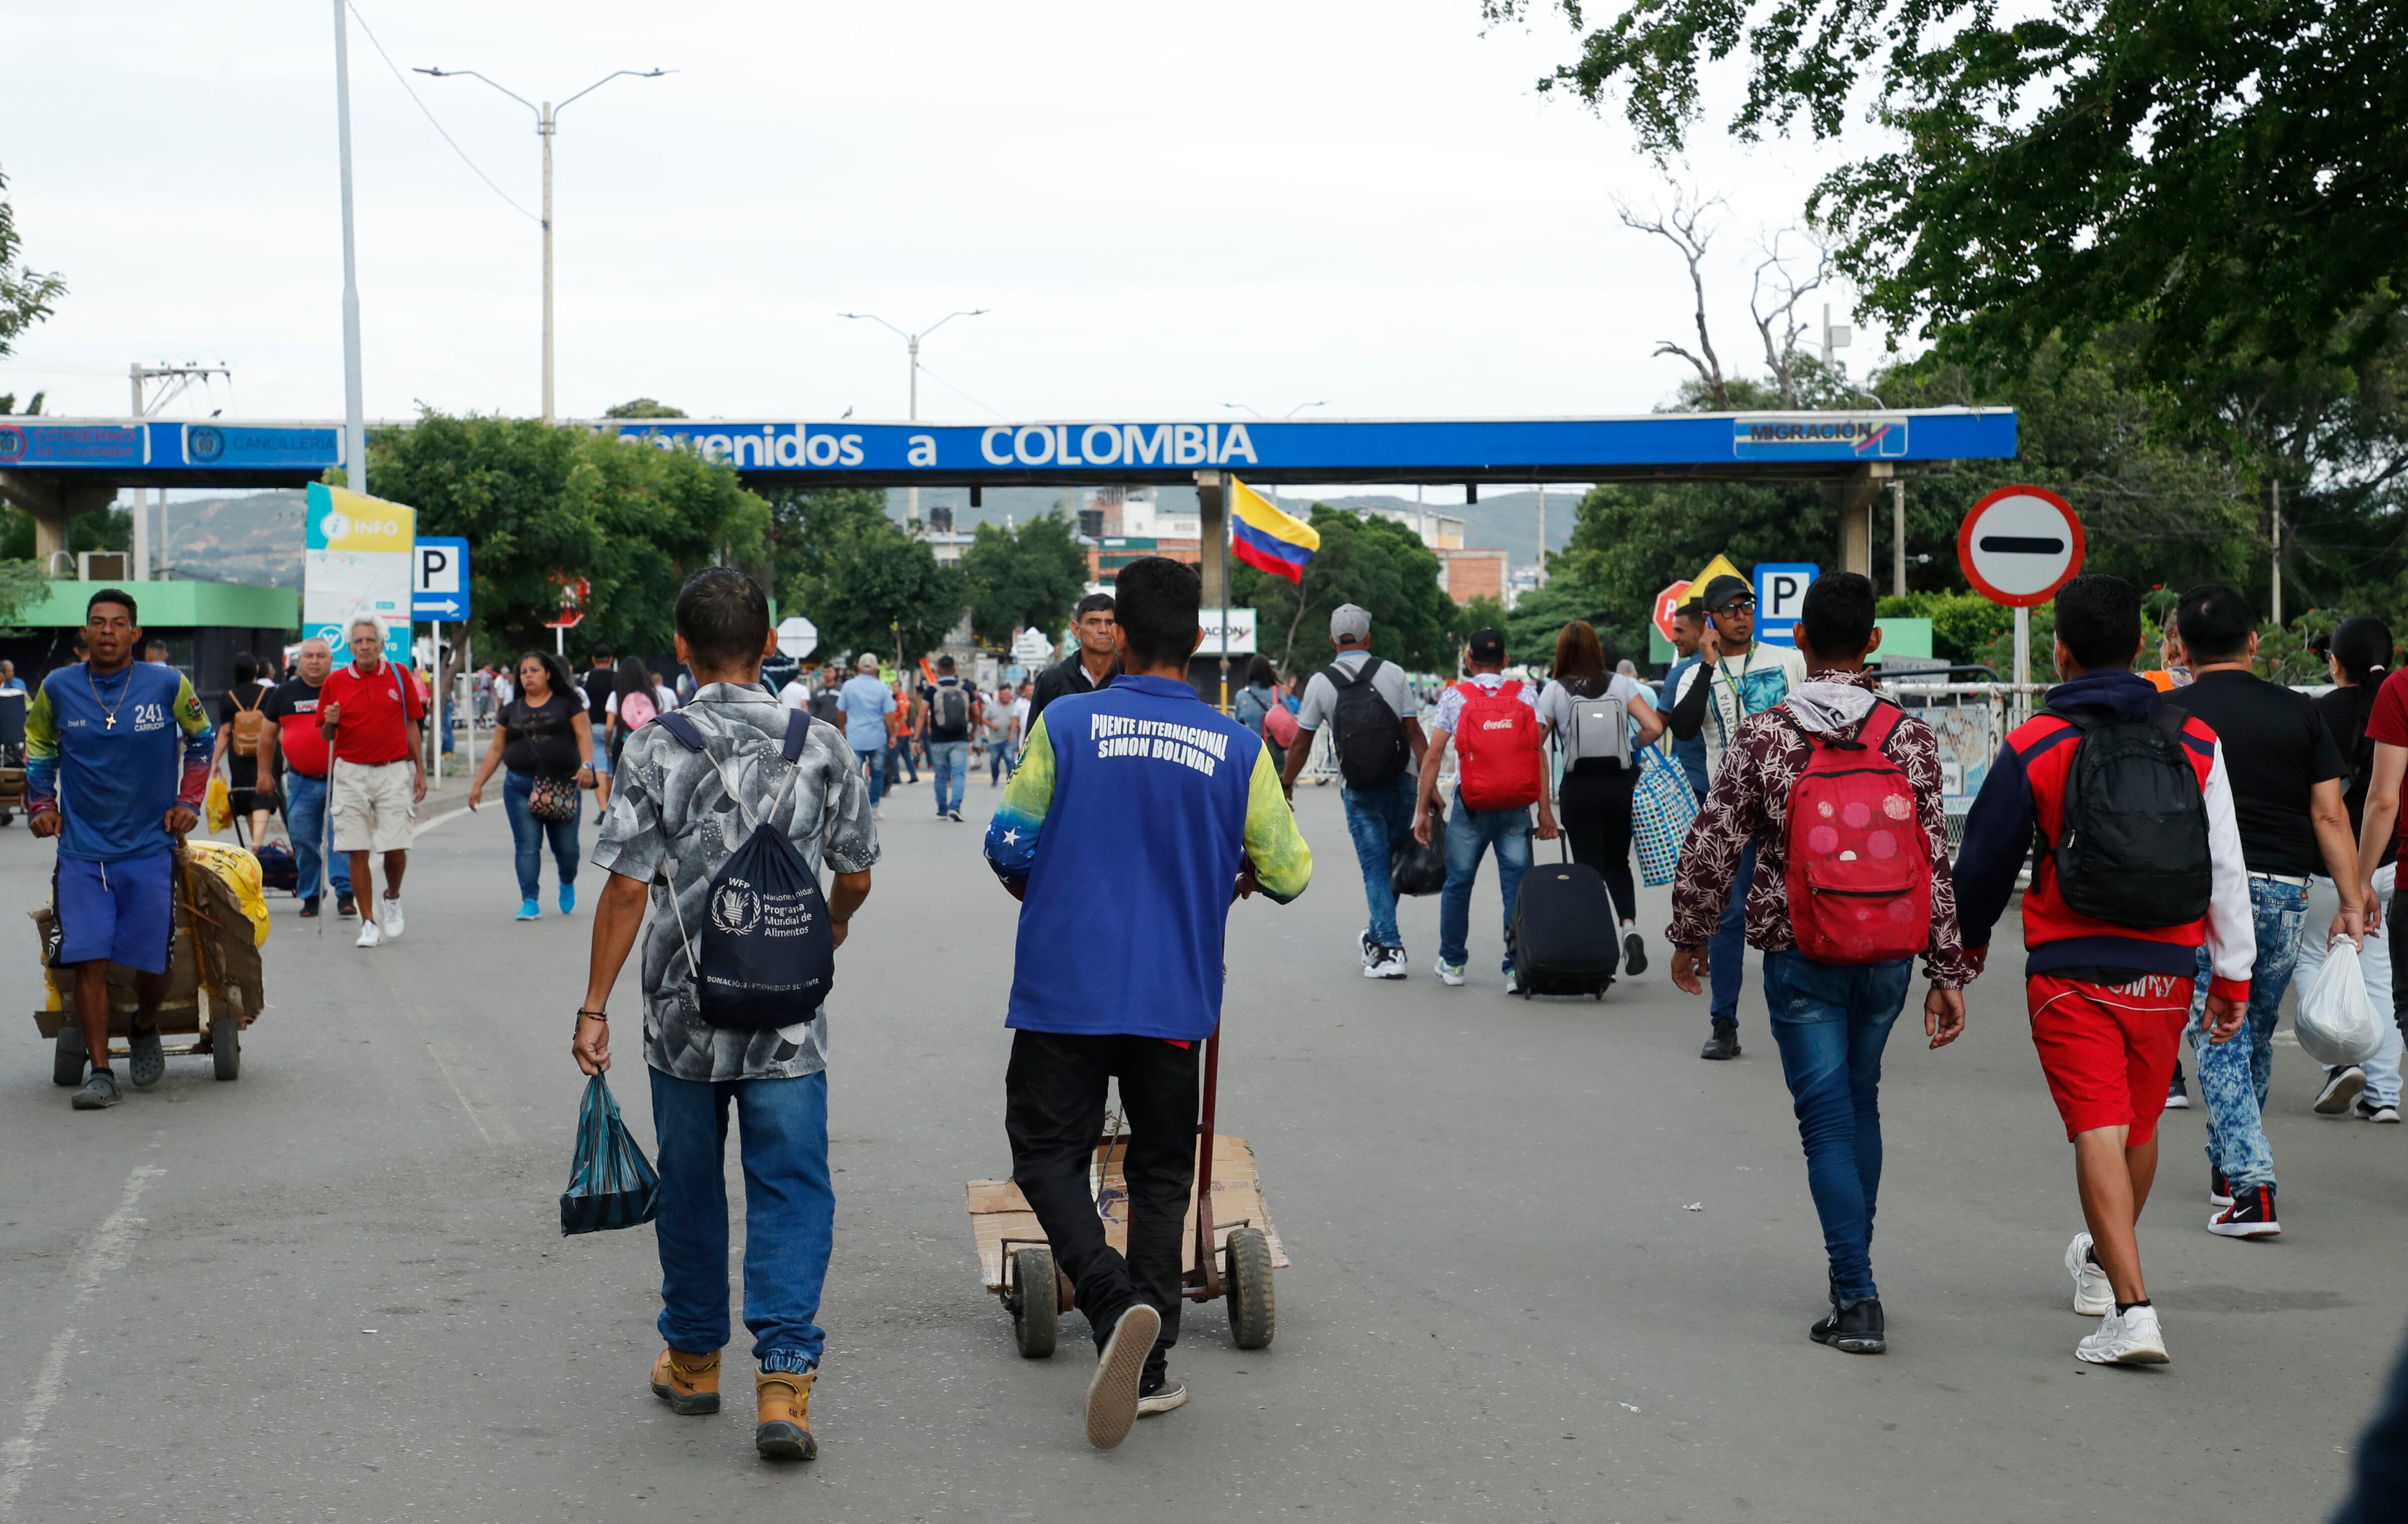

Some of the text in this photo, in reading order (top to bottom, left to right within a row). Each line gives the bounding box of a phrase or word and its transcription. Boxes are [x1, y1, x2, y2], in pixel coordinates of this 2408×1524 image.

[34, 429, 136, 443] GOBIERNO
[1750, 419, 1873, 440] MIGRACIÓN
[593, 424, 1259, 466] venidos a COLOMBIA
[354, 521, 398, 536] INFO
[424, 551, 446, 588] P
[1774, 577, 1797, 614] P
[135, 704, 164, 724] 241
[1720, 693, 1737, 735] ORNIA
[1091, 713, 1229, 762] PUENTE INTERNACIONAL
[1098, 737, 1215, 777] SIMON BOLIVAR
[728, 877, 750, 890] WFP
[763, 893, 793, 902] Nacione
[765, 913, 812, 925] Mundial de
[764, 926, 809, 937] Alimentos
[707, 976, 747, 989] DONACIÓN
[803, 978, 819, 988] ENTA
